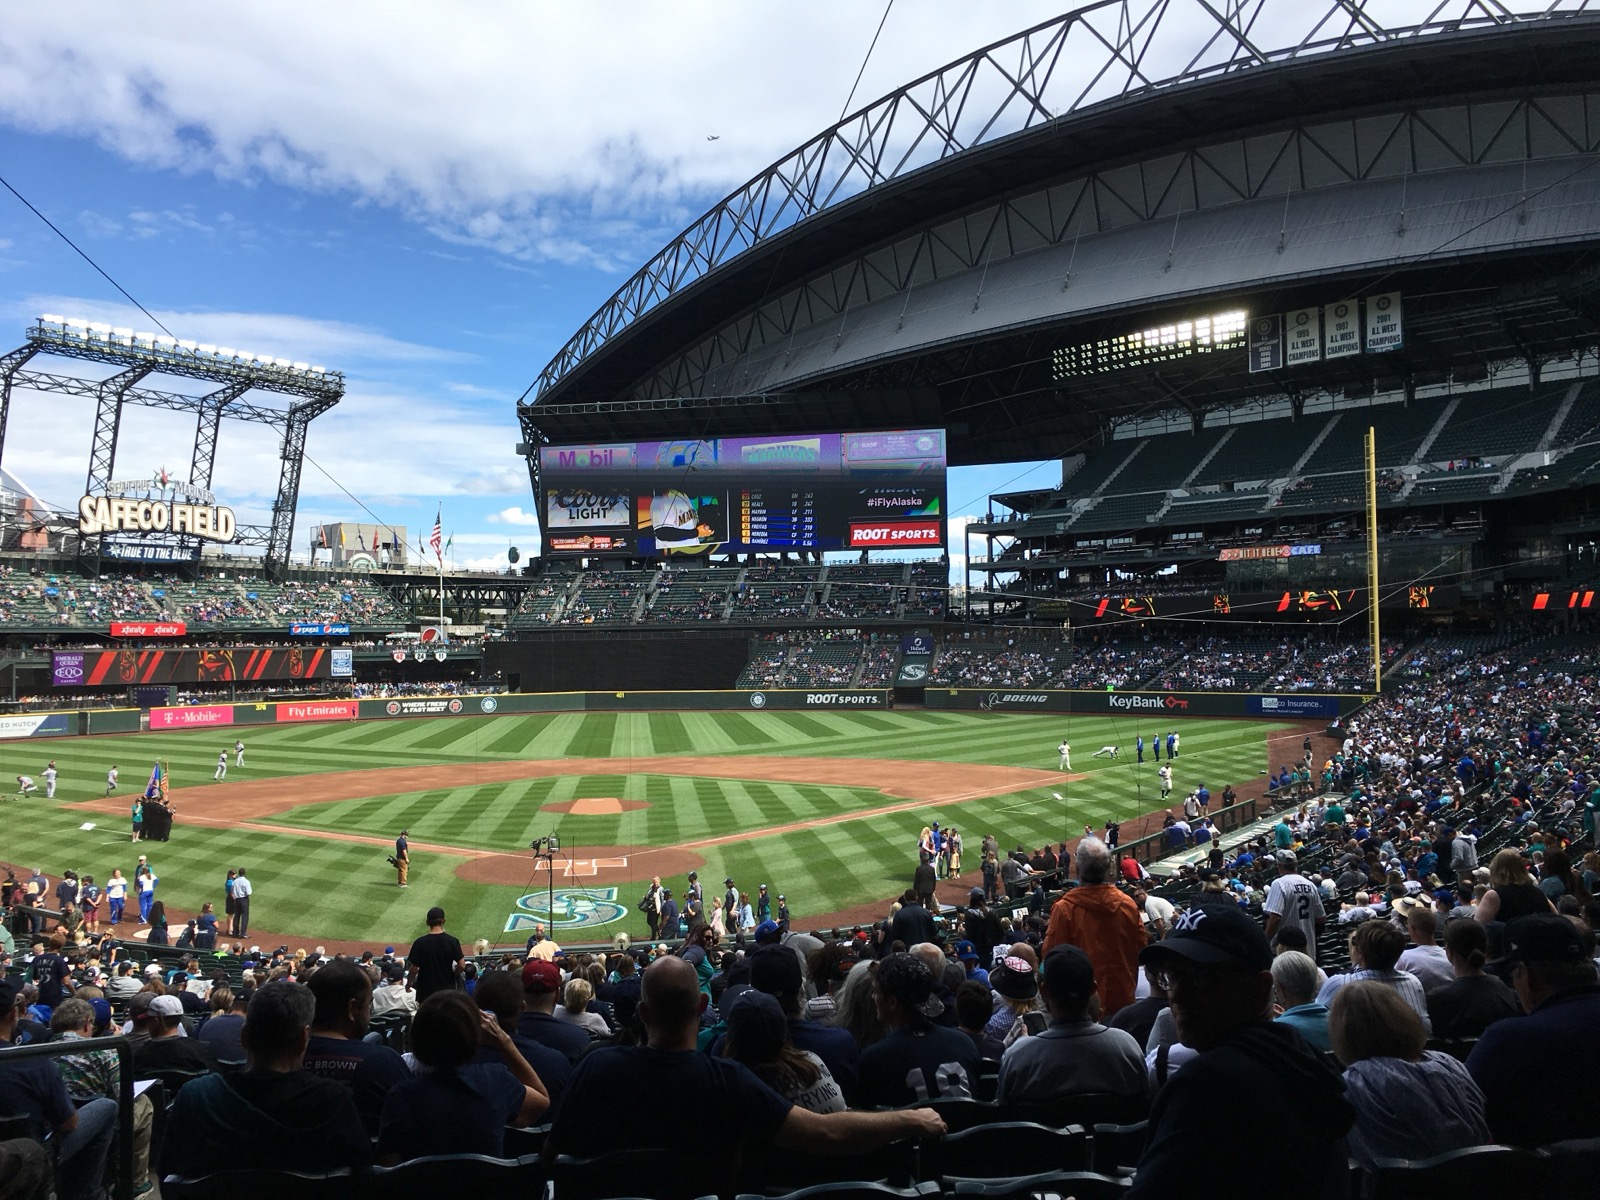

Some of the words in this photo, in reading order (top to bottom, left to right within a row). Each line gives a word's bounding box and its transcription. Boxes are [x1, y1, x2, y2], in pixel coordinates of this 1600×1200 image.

[1377, 314, 1391, 324] 2001
[1336, 321, 1348, 331] 1997
[1382, 324, 1397, 334] WEST
[1297, 329, 1309, 338] 1995
[1340, 332, 1355, 342] WEST
[1301, 338, 1315, 348] WEST
[1369, 334, 1401, 347] CHAMPIONS
[1289, 348, 1319, 361] CHAMPIONS
[1327, 342, 1359, 356] CHAMPIONS
[559, 449, 613, 468] Mobil
[107, 480, 151, 494] SEATTLE
[174, 480, 216, 505] MARINERS
[866, 497, 923, 508] #iFlyAlaska
[569, 507, 609, 520] LIGHT
[80, 496, 168, 536] SAFECO
[171, 502, 236, 543] FIELD
[852, 528, 890, 541] ROOT
[890, 528, 936, 540] SPORTS
[120, 545, 140, 557] TRUE
[141, 547, 152, 558] TO
[155, 549, 170, 559] THE
[172, 546, 193, 560] BLUE
[1239, 548, 1250, 558] HIT
[1252, 548, 1260, 558] IT
[1261, 547, 1280, 557] HERE
[1291, 545, 1321, 555] CAFE
[121, 625, 147, 635] xfinity
[154, 625, 178, 635] xfinity
[301, 626, 319, 635] pepsi
[332, 626, 350, 635] pepsi
[334, 652, 350, 660] BUILT
[806, 693, 838, 704] ROOT
[838, 695, 878, 704] SPORTS
[1002, 694, 1048, 703] BOEING
[1109, 695, 1165, 709] KeyBank
[1263, 699, 1286, 707] Safeco
[1287, 699, 1319, 708] Insurance
[289, 706, 305, 717] Fly
[306, 705, 348, 715] Emirates
[1293, 884, 1312, 894] JETER
[1297, 896, 1310, 920] 2
[314, 1060, 358, 1071] BROWN
